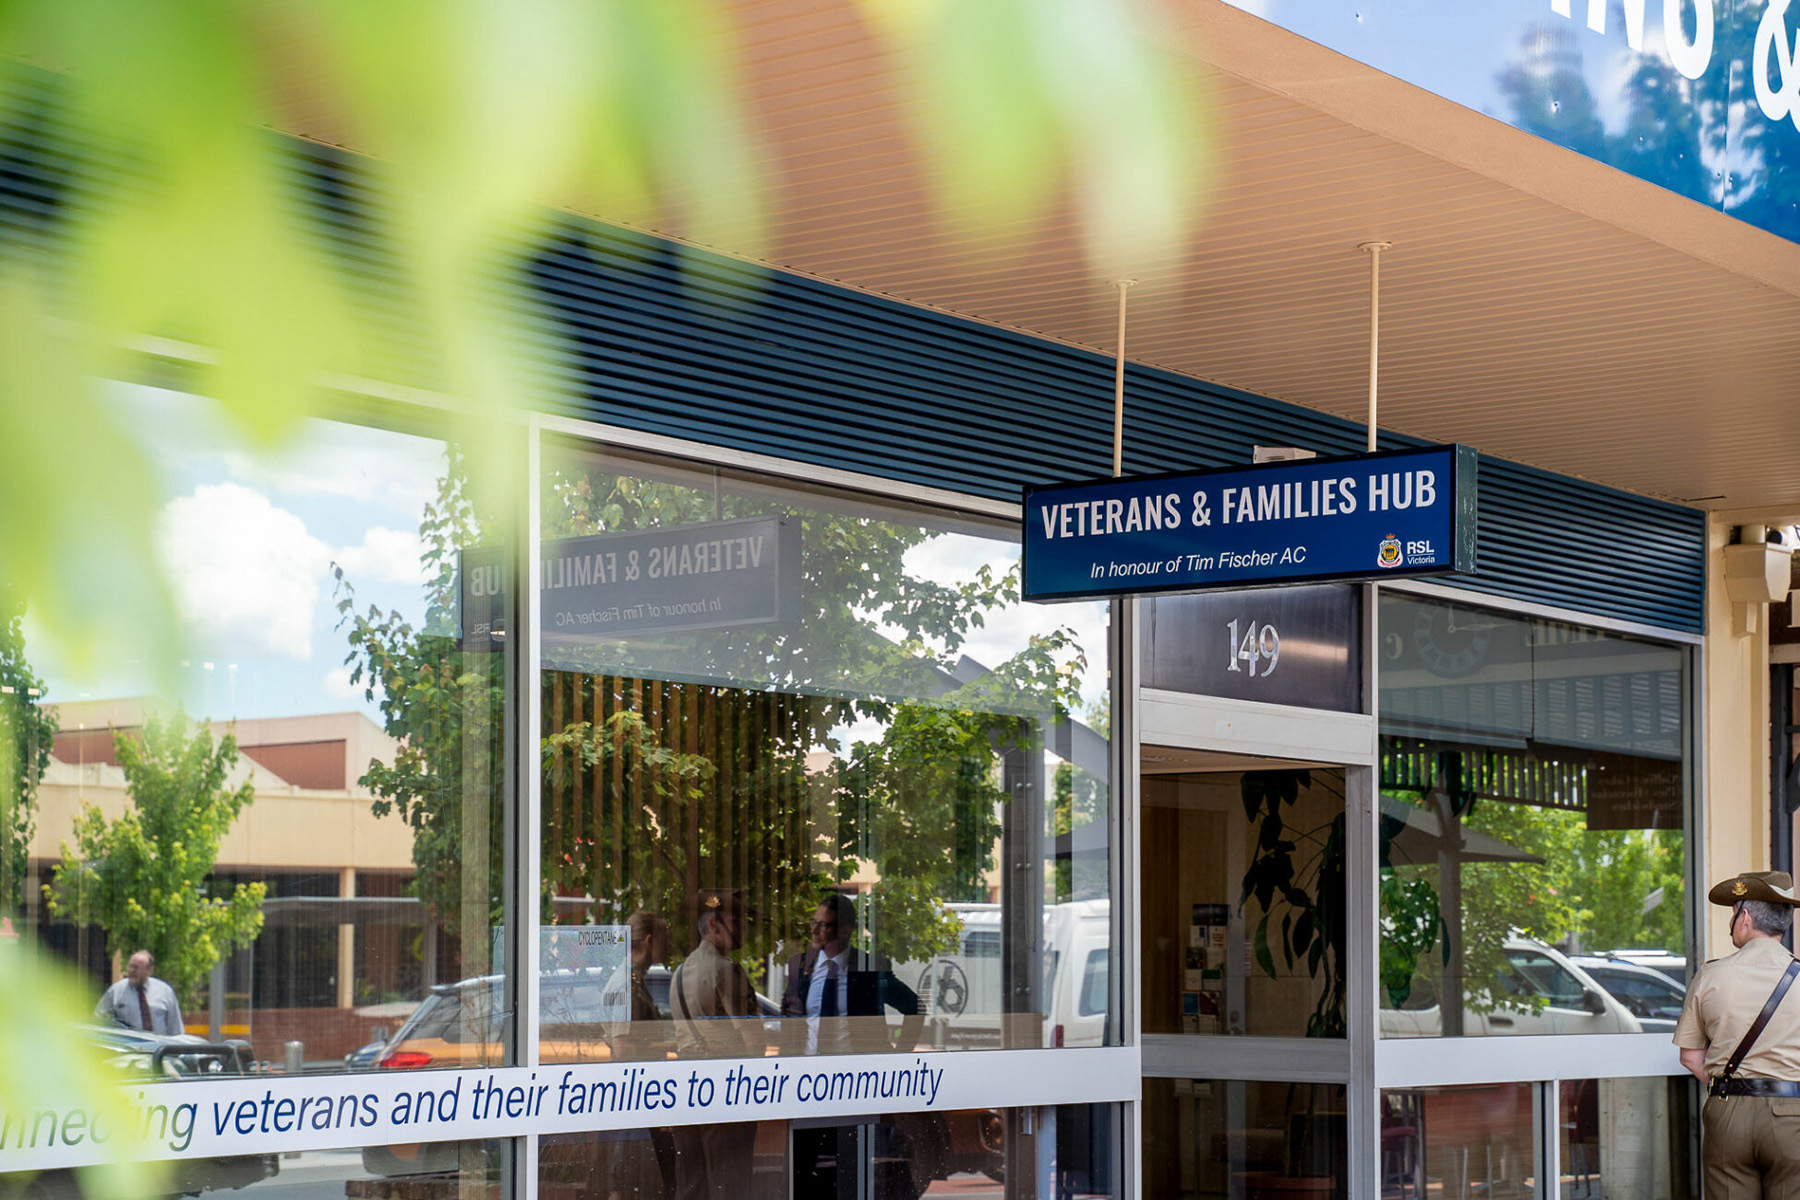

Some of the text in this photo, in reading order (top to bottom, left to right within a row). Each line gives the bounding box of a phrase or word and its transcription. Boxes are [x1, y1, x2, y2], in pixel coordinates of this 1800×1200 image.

[1041, 469, 1437, 539] VETERANS & FAMILIES HUB
[1090, 546, 1307, 579] In honour of Tim Fischer AC
[1406, 541, 1435, 555] RSL
[1407, 555, 1436, 565] Victoria
[1226, 617, 1281, 678] 149
[213, 1090, 380, 1136] veterans
[391, 1076, 463, 1126] and
[471, 1074, 549, 1120] their
[557, 1068, 678, 1115] families
[688, 1070, 716, 1107] to
[725, 1063, 791, 1106] their
[797, 1058, 945, 1106] community
